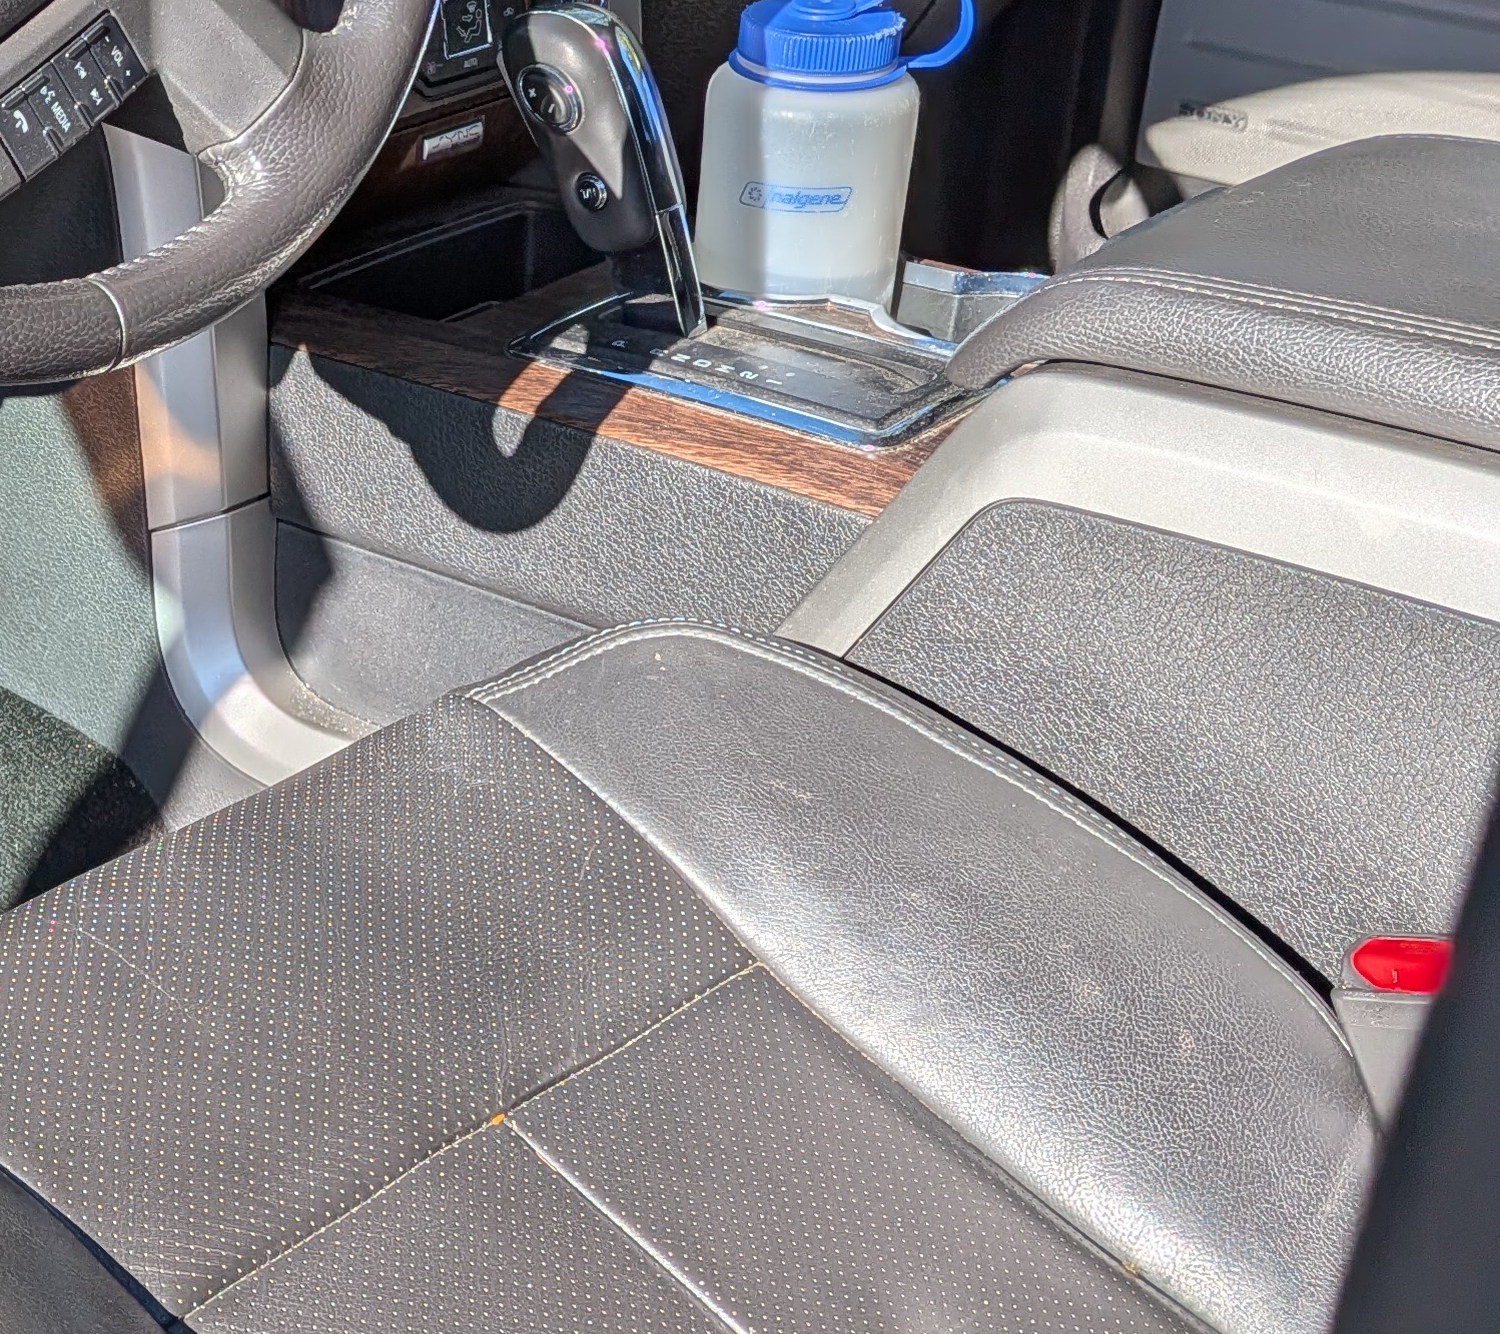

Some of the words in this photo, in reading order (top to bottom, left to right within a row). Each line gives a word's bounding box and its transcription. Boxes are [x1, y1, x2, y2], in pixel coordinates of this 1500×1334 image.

[110, 44, 125, 68] VOL
[50, 101, 72, 134] MEDIA
[670, 353, 691, 363] N
[692, 358, 712, 368] D
[714, 364, 736, 374] M
[739, 370, 759, 380] 2
